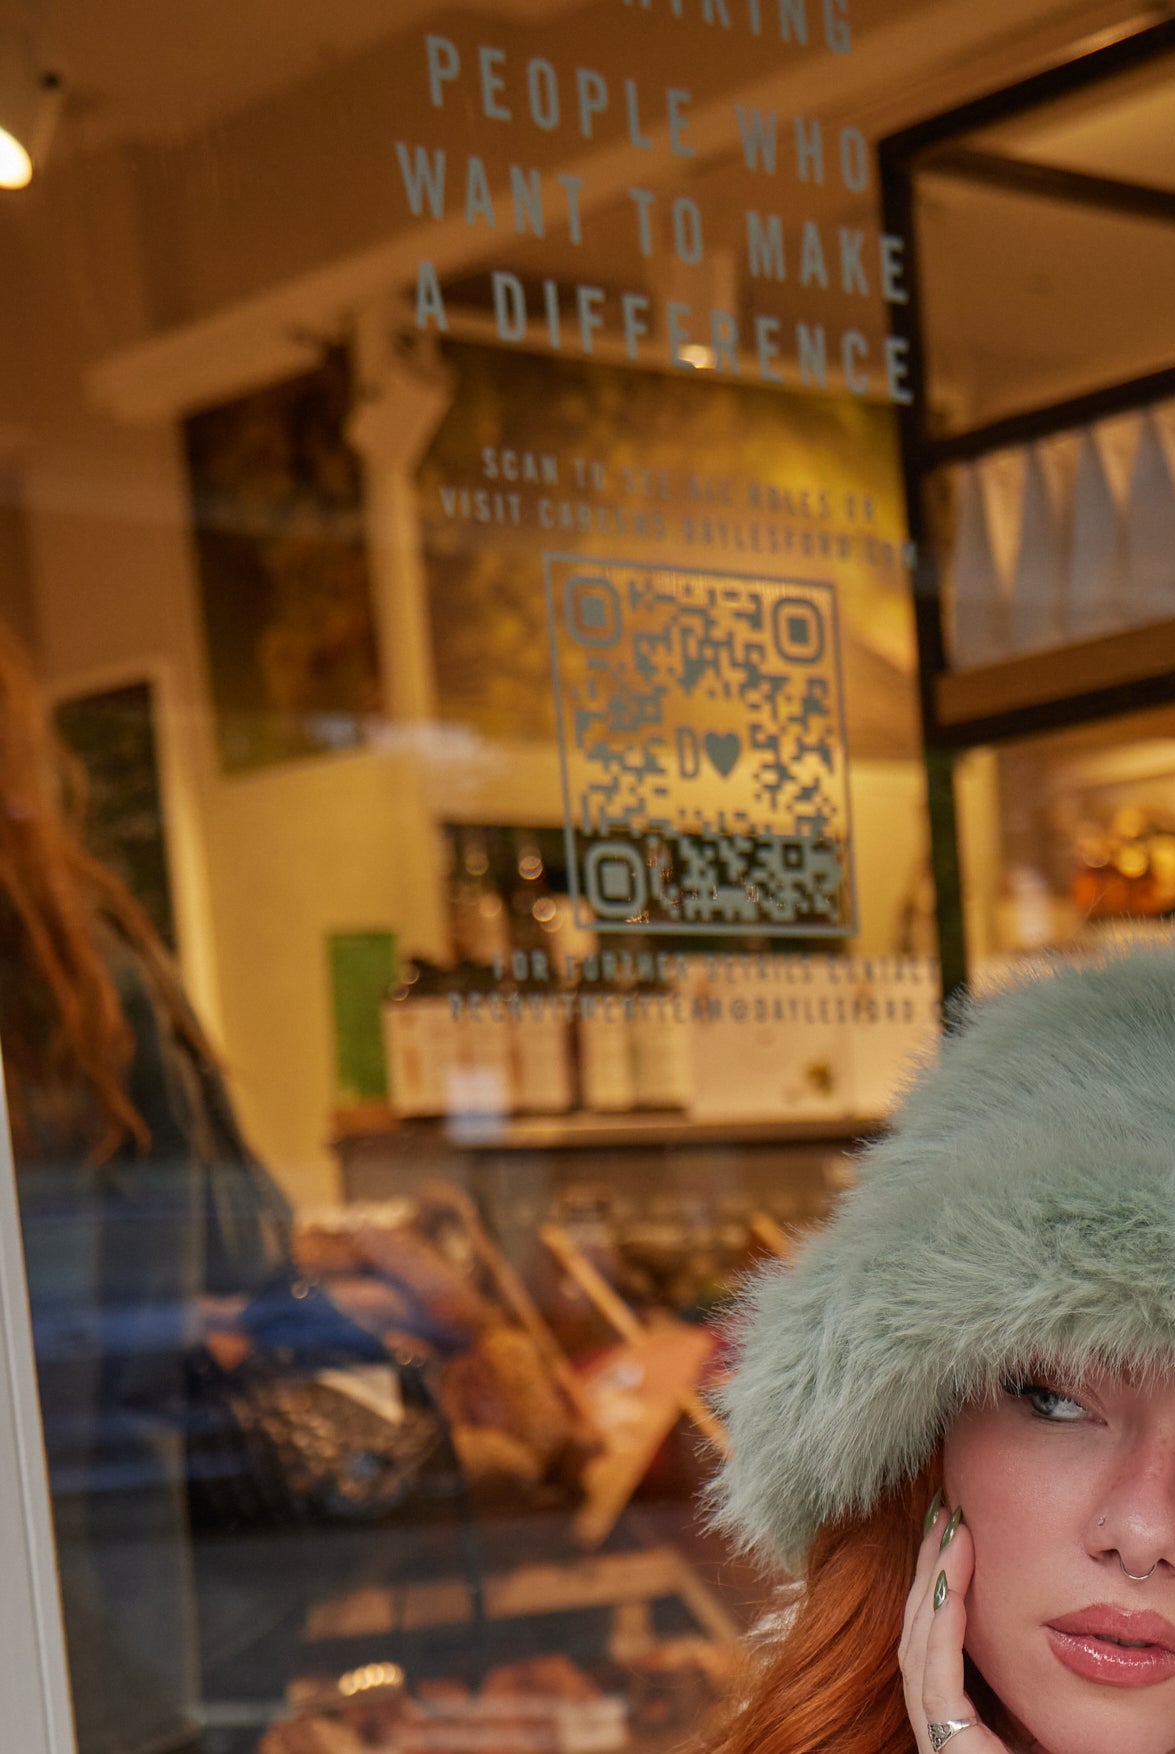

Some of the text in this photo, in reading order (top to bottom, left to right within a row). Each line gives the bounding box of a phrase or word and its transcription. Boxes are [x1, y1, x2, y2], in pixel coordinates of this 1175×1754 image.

[622, 0, 853, 56] ING
[426, 34, 869, 193] PEOPLE WHO
[396, 142, 909, 305] WANT TO MAKE
[416, 261, 913, 405] A DIFFERENCE
[439, 483, 522, 526] VISIT
[482, 447, 558, 485] SCAN
